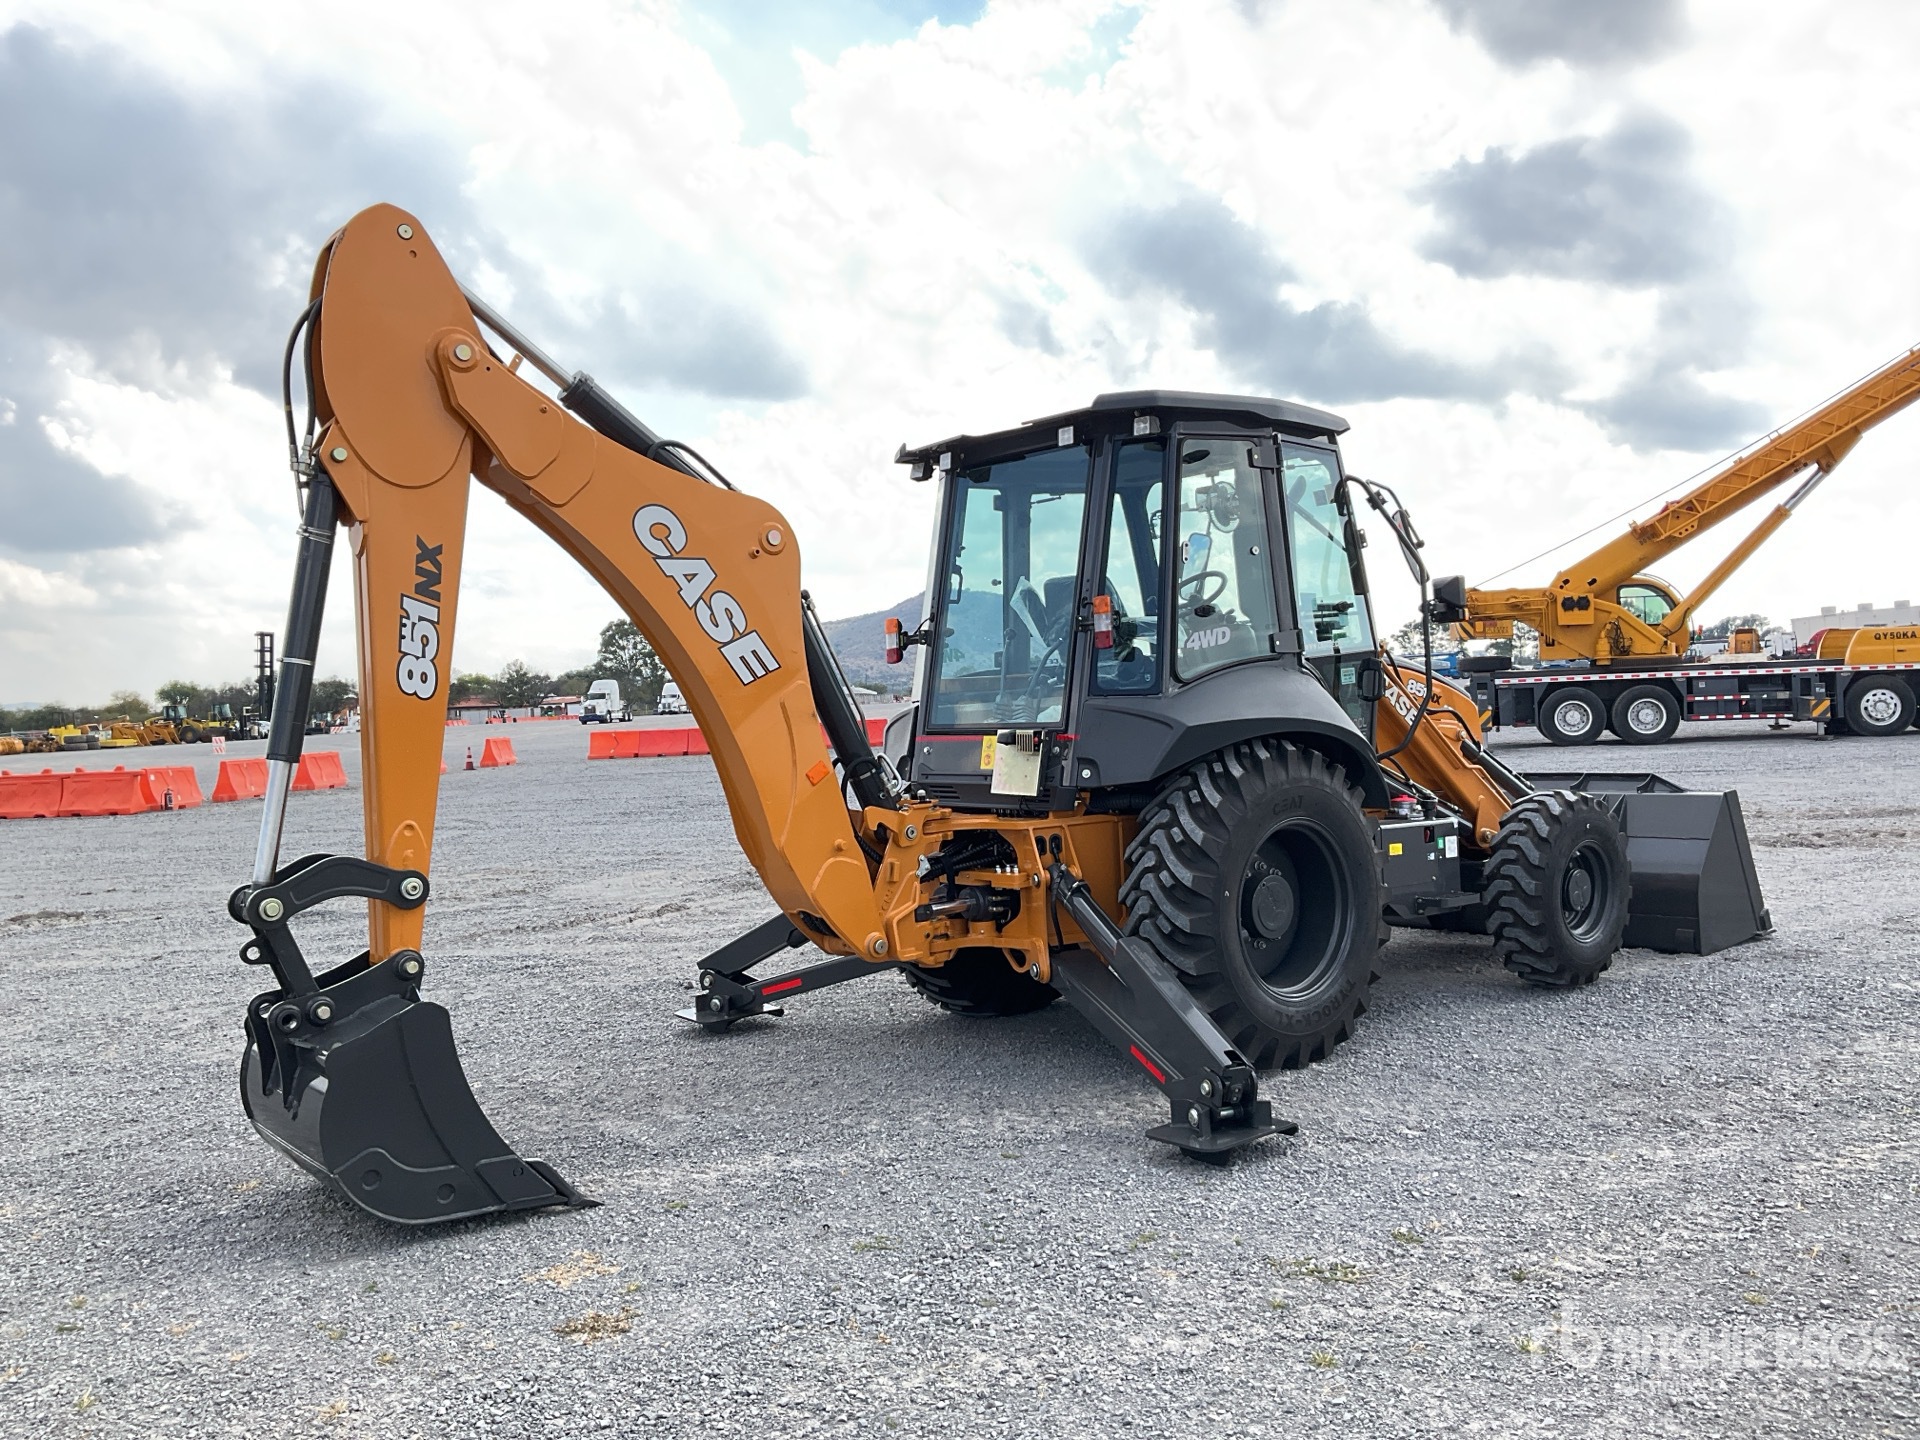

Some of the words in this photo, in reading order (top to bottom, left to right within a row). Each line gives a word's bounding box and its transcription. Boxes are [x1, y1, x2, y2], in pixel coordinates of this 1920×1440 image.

[632, 504, 782, 686] CASE
[1187, 627, 1231, 650] 4WD
[1873, 631, 1917, 641] QY50KA
